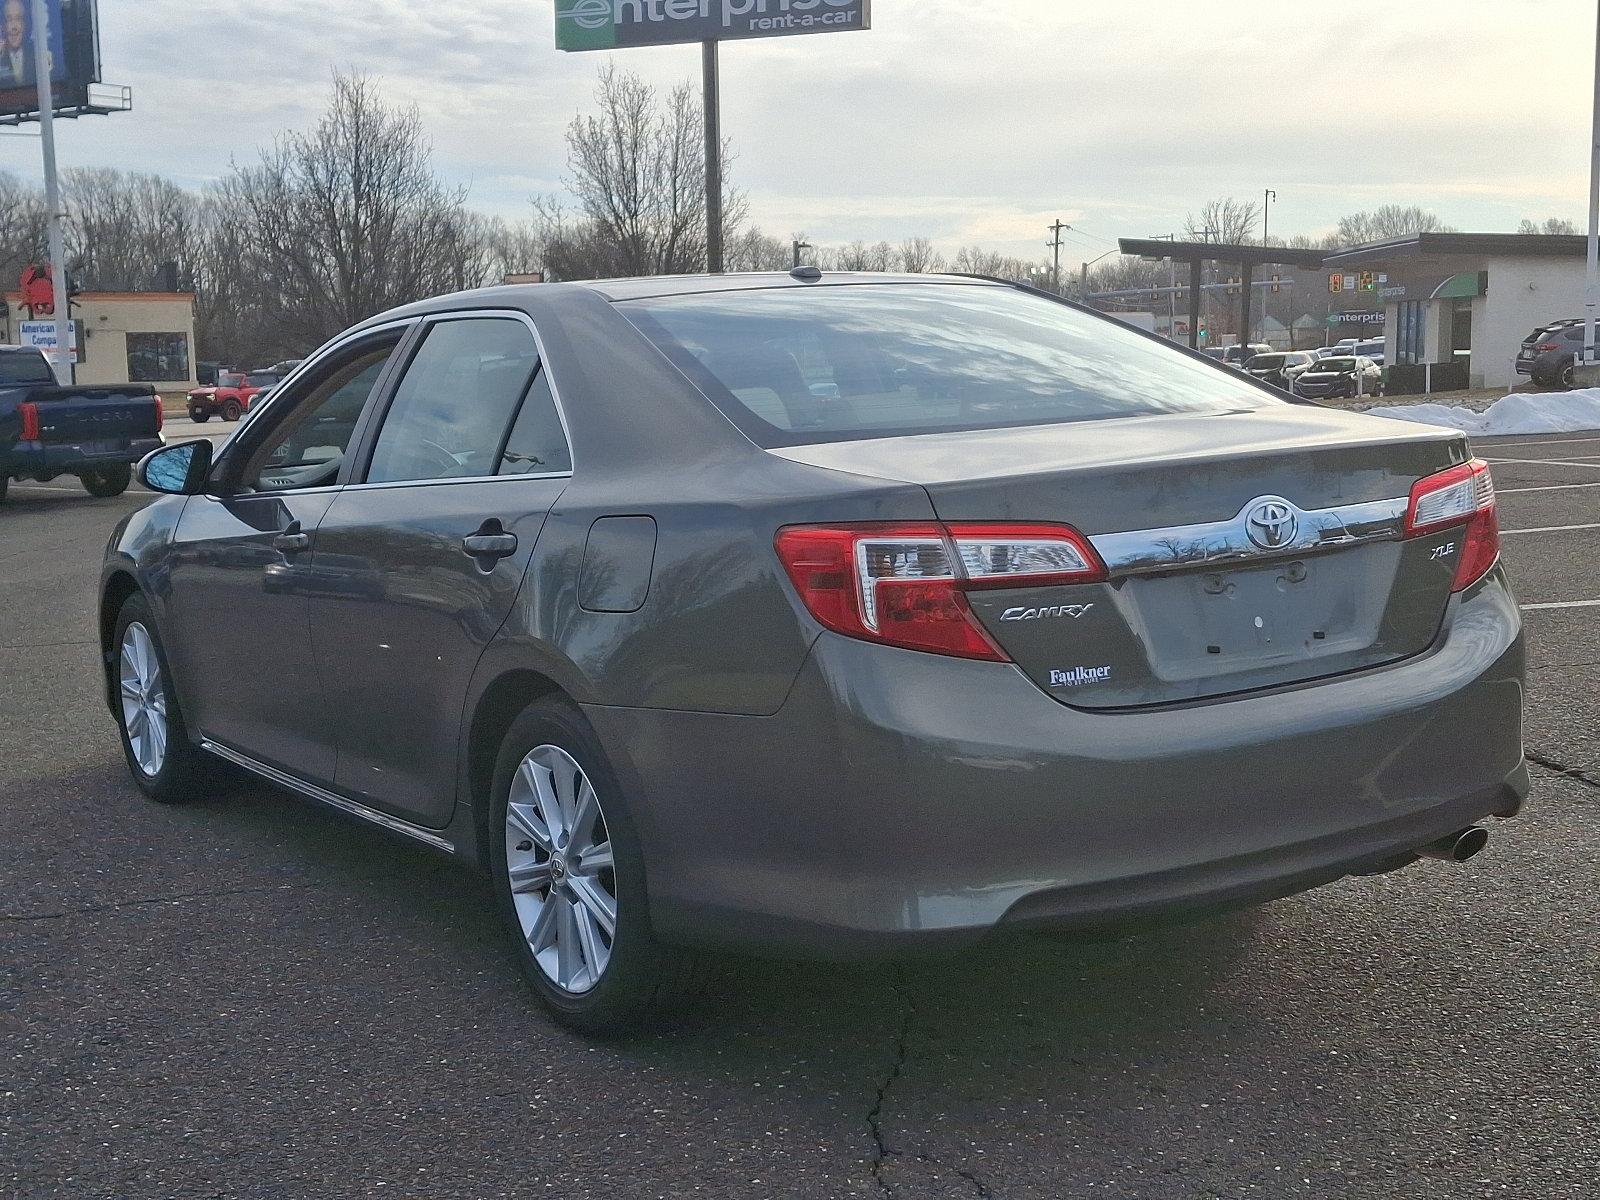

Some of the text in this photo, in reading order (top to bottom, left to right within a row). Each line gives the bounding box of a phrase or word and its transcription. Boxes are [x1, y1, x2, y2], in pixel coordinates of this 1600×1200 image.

[749, 10, 857, 31] rent-a-car
[1328, 312, 1385, 323] enterpris
[22, 322, 55, 333] American
[1427, 542, 1455, 560] XLE
[1000, 602, 1094, 621] CAMRY
[1049, 665, 1111, 684] Faulkner
